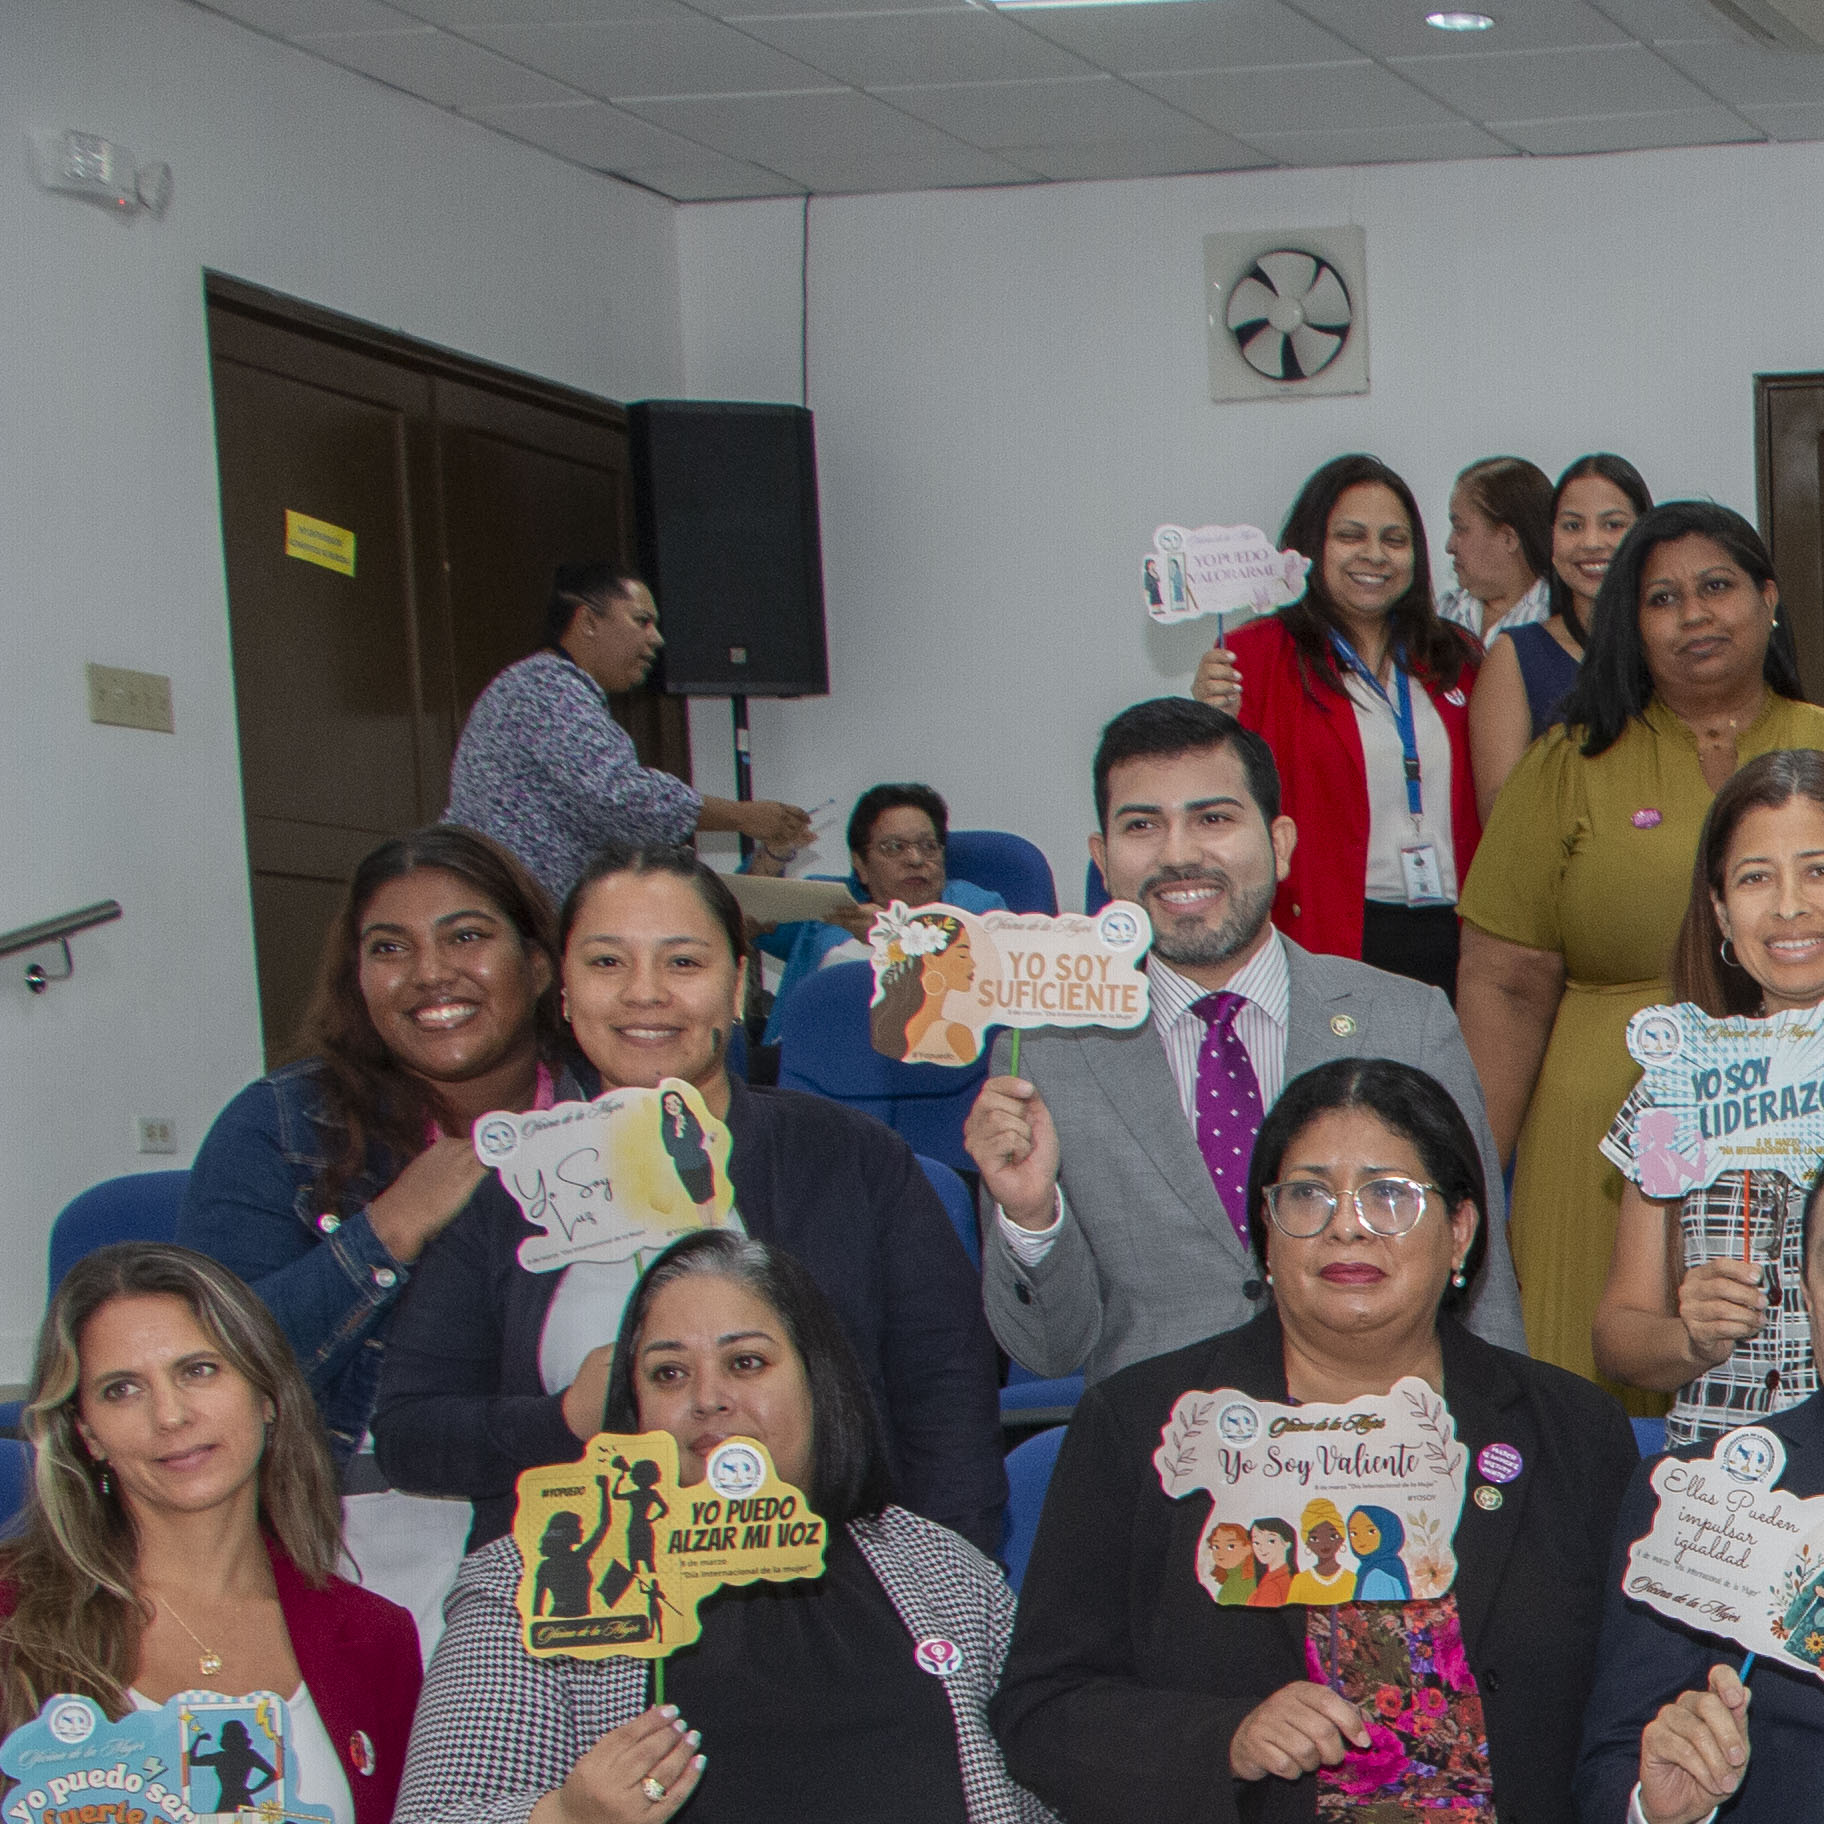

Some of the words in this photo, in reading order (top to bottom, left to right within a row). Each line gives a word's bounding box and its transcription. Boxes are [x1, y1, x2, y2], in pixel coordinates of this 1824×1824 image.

[1186, 565, 1274, 584] VALORARME
[1194, 554, 1215, 568] YO
[1216, 551, 1269, 566] PUEDO
[1008, 952, 1045, 980] YO
[1056, 953, 1113, 982] SOY
[978, 980, 1138, 1013] SUFICIENTE
[1691, 1068, 1722, 1101] YO
[1725, 1056, 1772, 1095] SOY
[513, 1168, 557, 1219] Yo
[556, 1148, 613, 1201] Soy
[1218, 1447, 1257, 1485] Yo
[1263, 1445, 1314, 1485] Soy
[1316, 1442, 1424, 1479] Valiente
[691, 1500, 721, 1525] YO
[726, 1496, 796, 1524] PUEDO
[1663, 1467, 1719, 1507] Ellas
[1726, 1489, 1800, 1534] Pueden
[667, 1528, 736, 1554] ALZAR
[741, 1526, 773, 1549] MI
[777, 1522, 821, 1547] VOZ
[1678, 1506, 1759, 1547] impulsar
[1673, 1531, 1751, 1570] igualdad
[47, 1763, 144, 1805] puedo
[145, 1781, 197, 1824] ser
